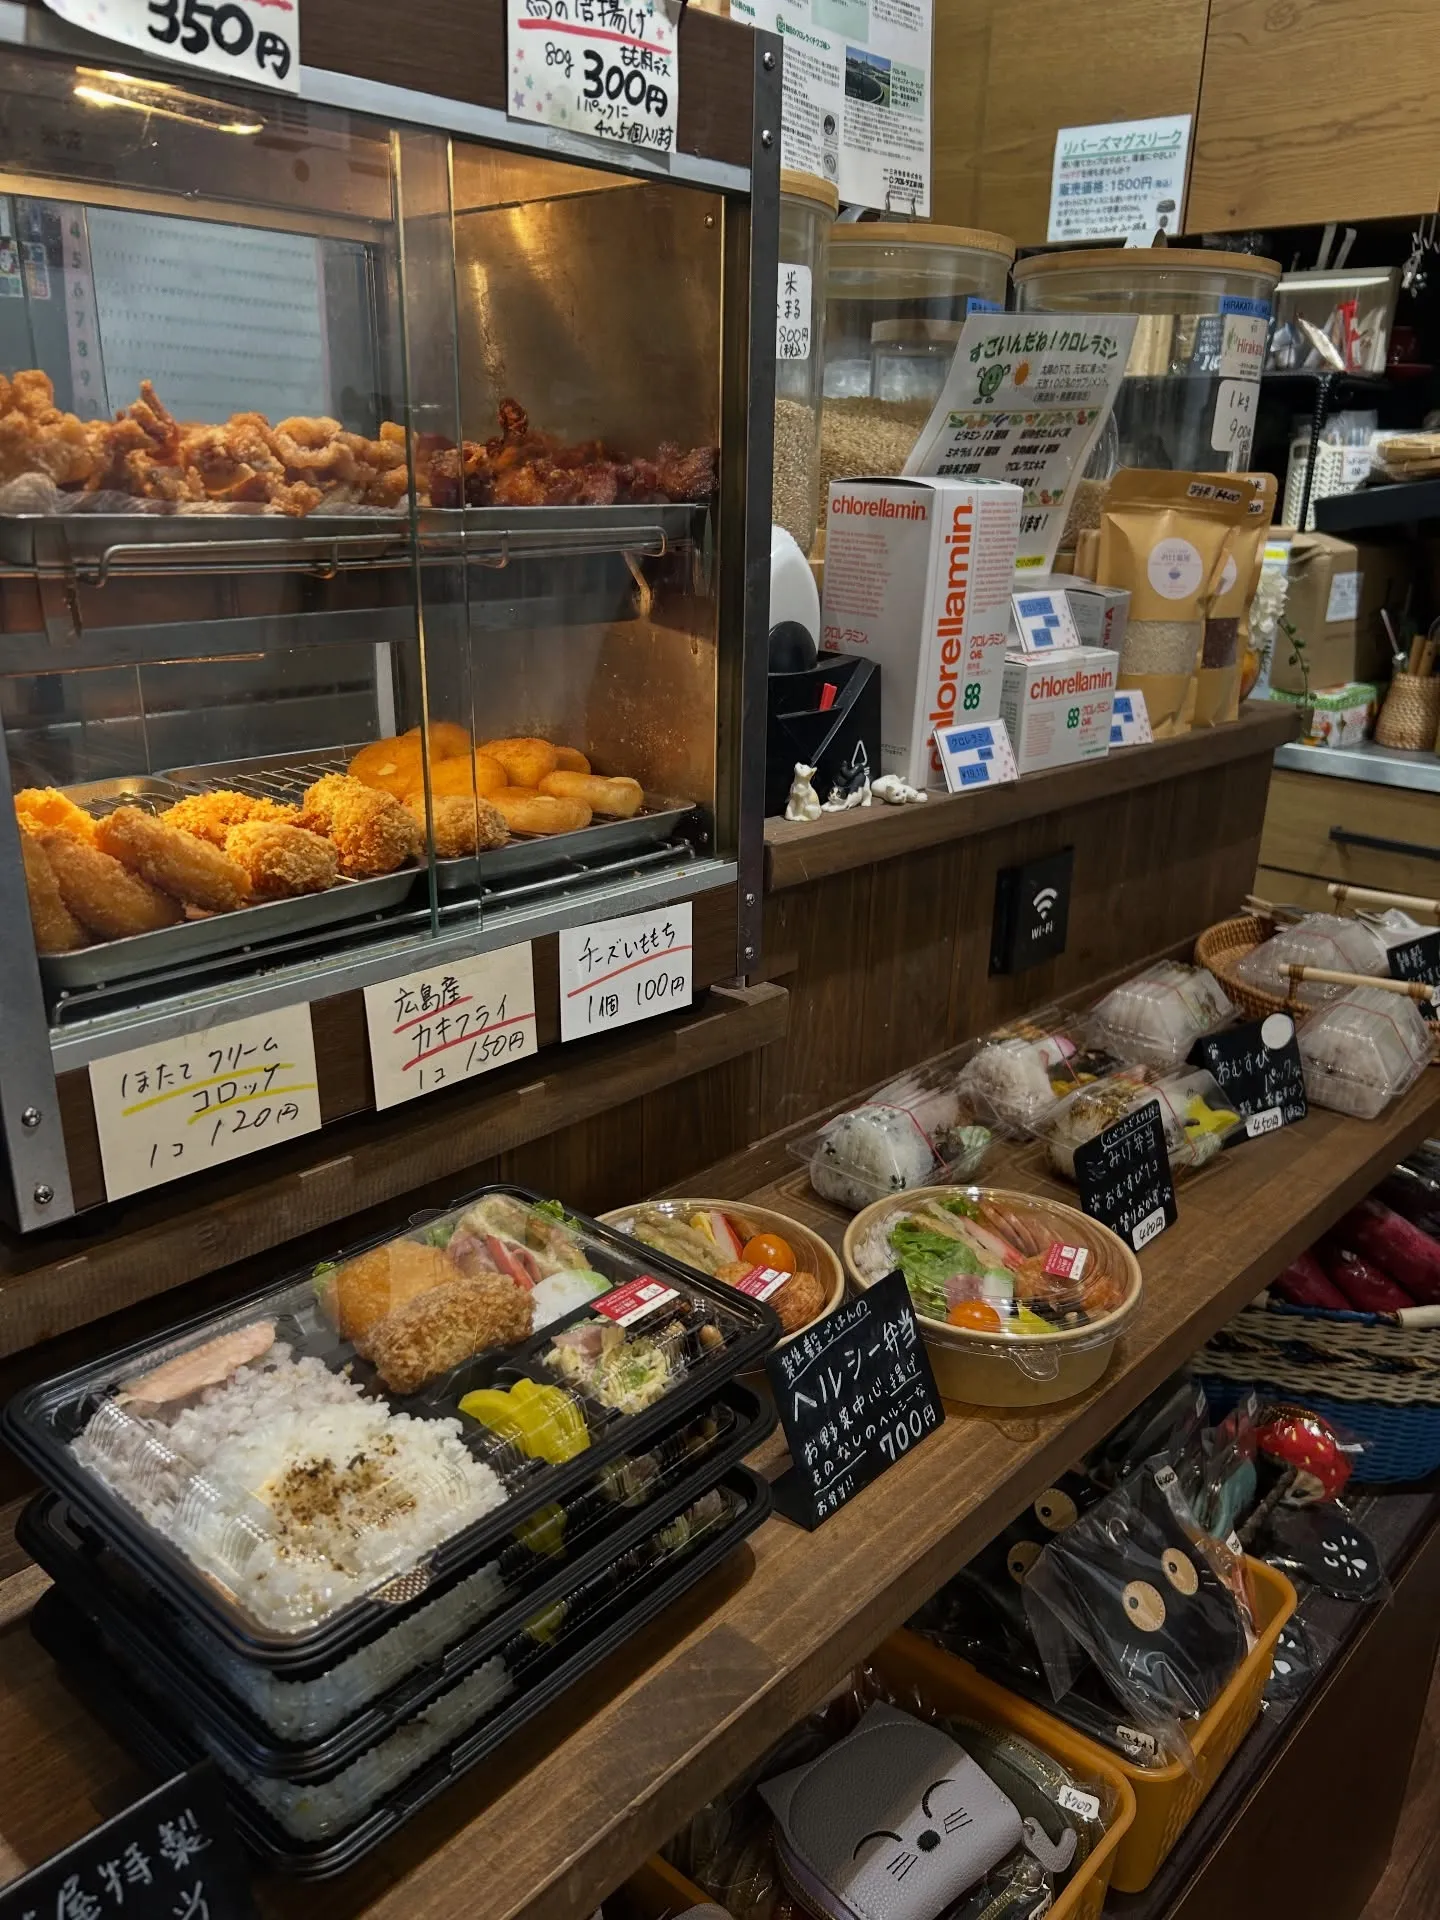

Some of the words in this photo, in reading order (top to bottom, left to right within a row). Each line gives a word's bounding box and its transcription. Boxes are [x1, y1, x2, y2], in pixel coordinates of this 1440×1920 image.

[148, 0, 291, 79] 350円
[544, 42, 575, 78] 80g
[582, 49, 668, 118] 300円
[832, 495, 928, 521] chlorellamin
[824, 625, 869, 644] クロレラミン
[970, 633, 1007, 649] クロレラミン
[1030, 667, 1114, 700] chlorellamin
[578, 922, 677, 973] チーズいももち
[394, 976, 463, 1023] 広島産
[588, 993, 620, 1025] 1個
[636, 973, 685, 1006] 100円
[411, 994, 508, 1058] カキフライ
[465, 1030, 525, 1072] 150円
[120, 1063, 193, 1099] ほたて
[208, 1036, 279, 1074] クリーム
[192, 1062, 281, 1113] コロッケ
[210, 1102, 299, 1147] 120円
[794, 1308, 917, 1422] ヘルシー弁当
[880, 1403, 937, 1461] 700円
